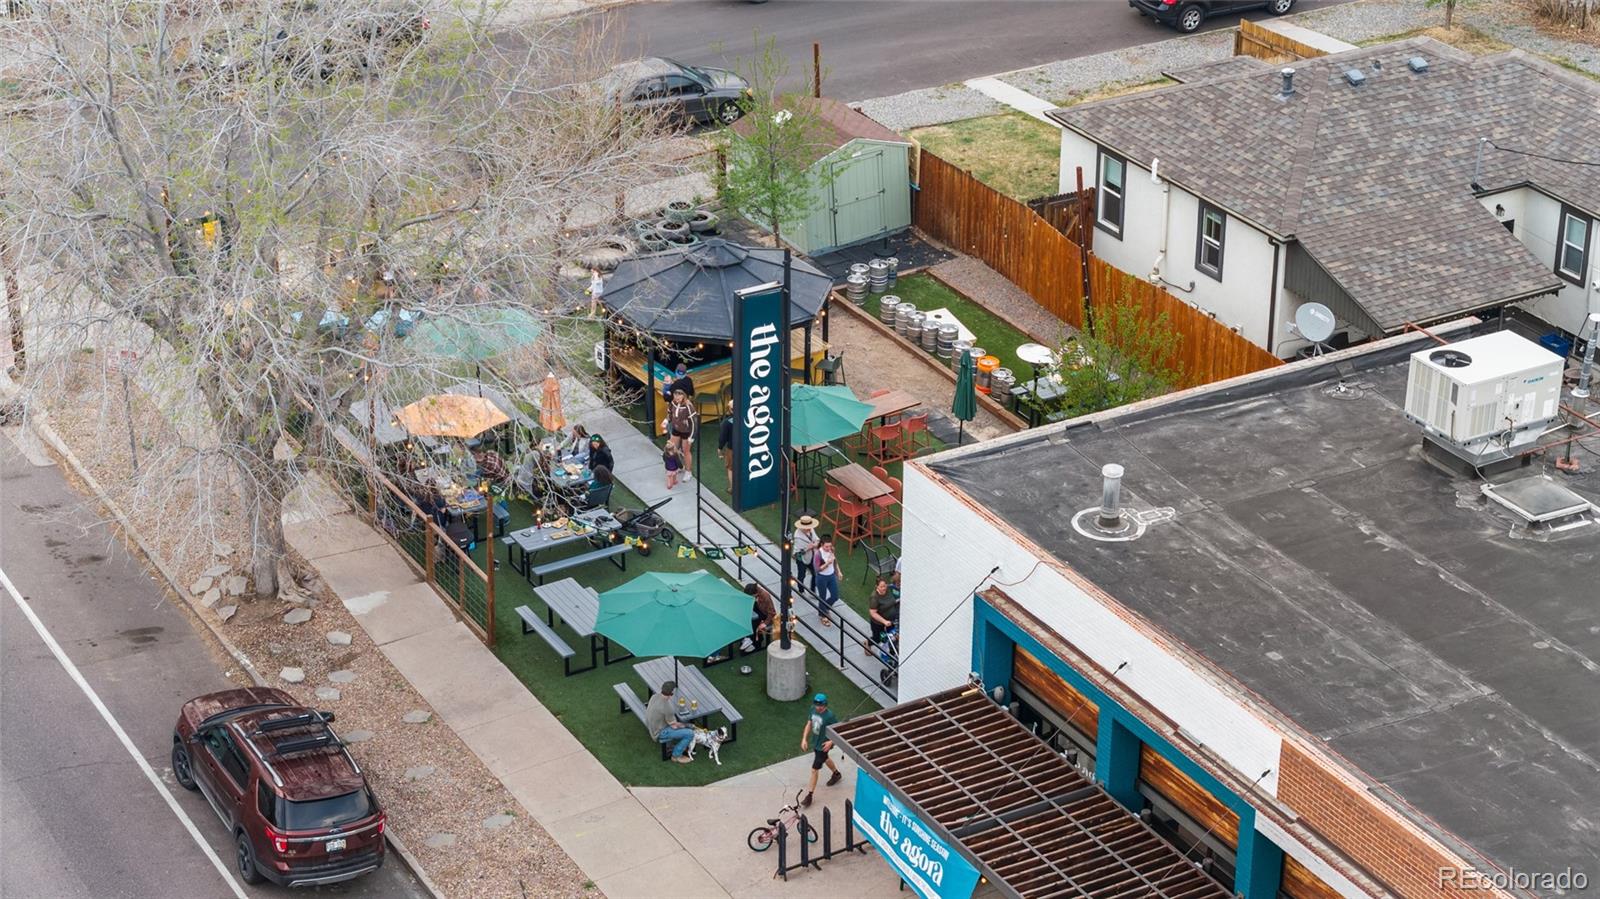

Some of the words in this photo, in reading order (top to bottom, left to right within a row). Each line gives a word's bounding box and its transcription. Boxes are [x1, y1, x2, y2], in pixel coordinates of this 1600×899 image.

[750, 322, 779, 380] the
[743, 384, 775, 481] agora
[879, 810, 900, 845] the
[900, 837, 943, 887] agora
